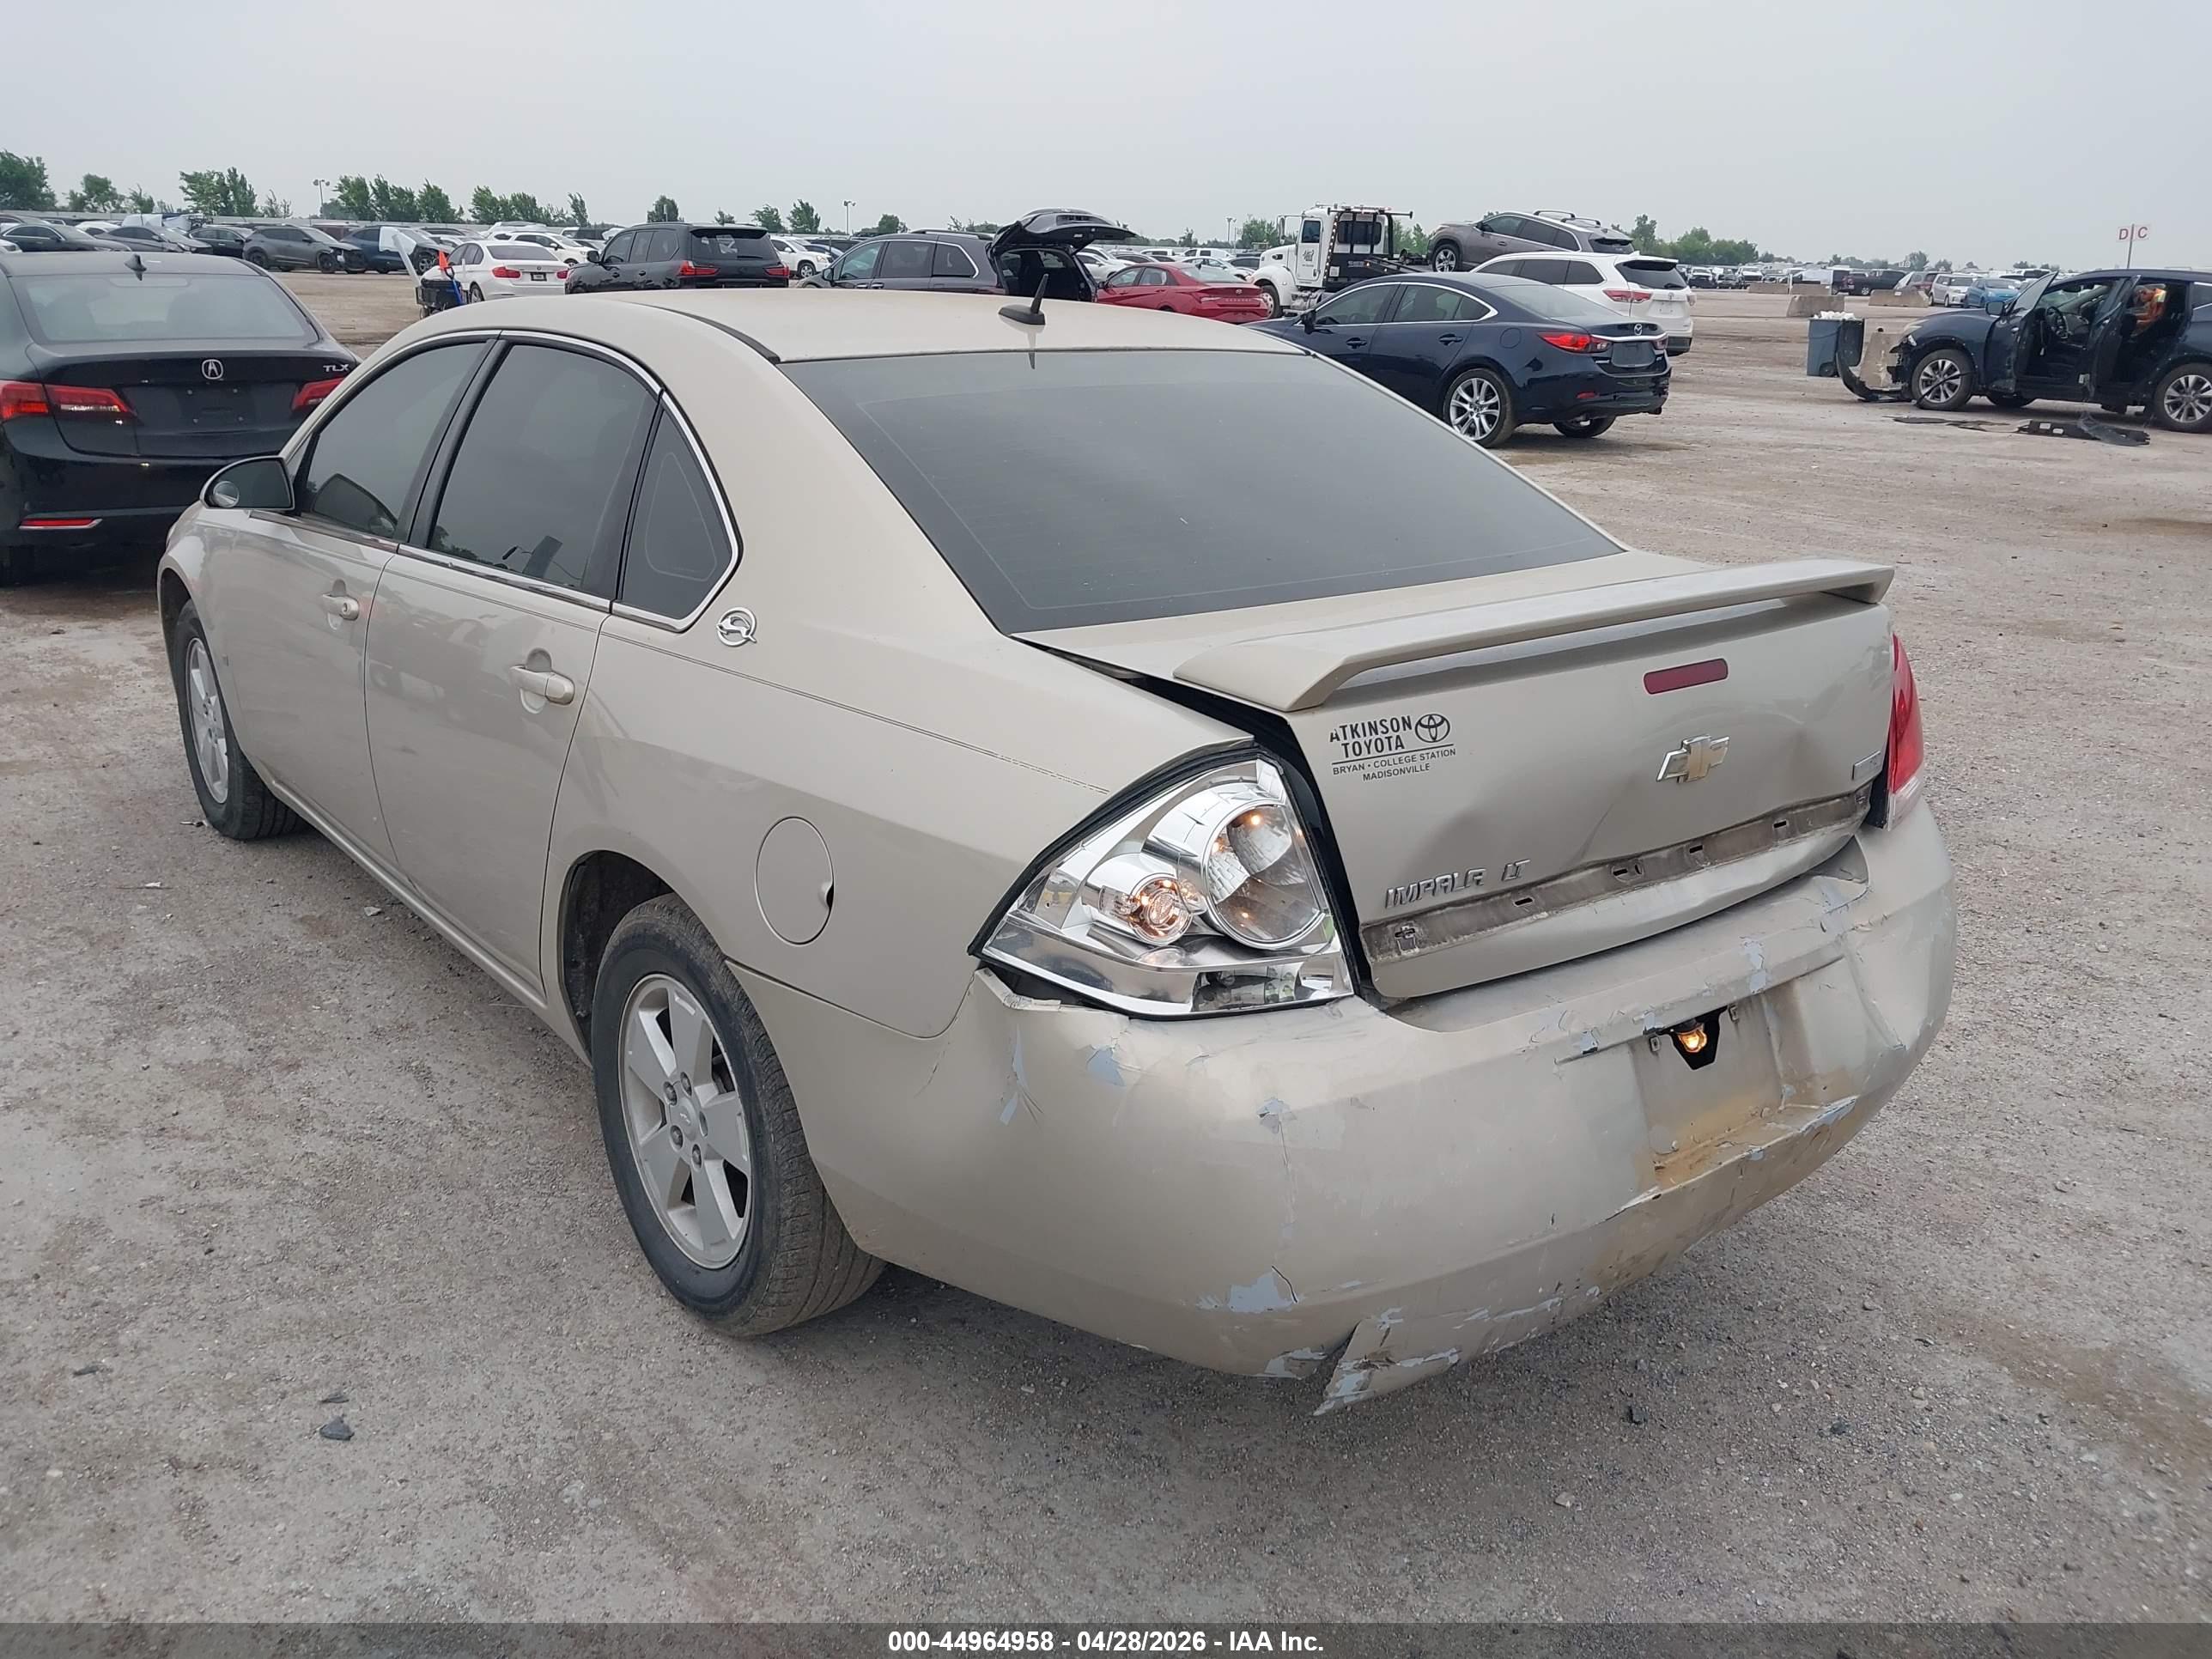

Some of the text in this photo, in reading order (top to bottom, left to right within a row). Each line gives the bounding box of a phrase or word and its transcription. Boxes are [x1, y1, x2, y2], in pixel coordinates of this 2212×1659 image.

[2119, 228, 2129, 240] D
[2137, 227, 2148, 239] C
[1329, 715, 1413, 743] ATKINSON
[1341, 734, 1405, 758] TOYOTA
[1333, 763, 1364, 775] BRYAN
[1374, 755, 1417, 768] COLLEGE
[1419, 748, 1456, 761] STATION
[1363, 763, 1431, 781] MADISONVILLE
[1502, 859, 1531, 881] LT
